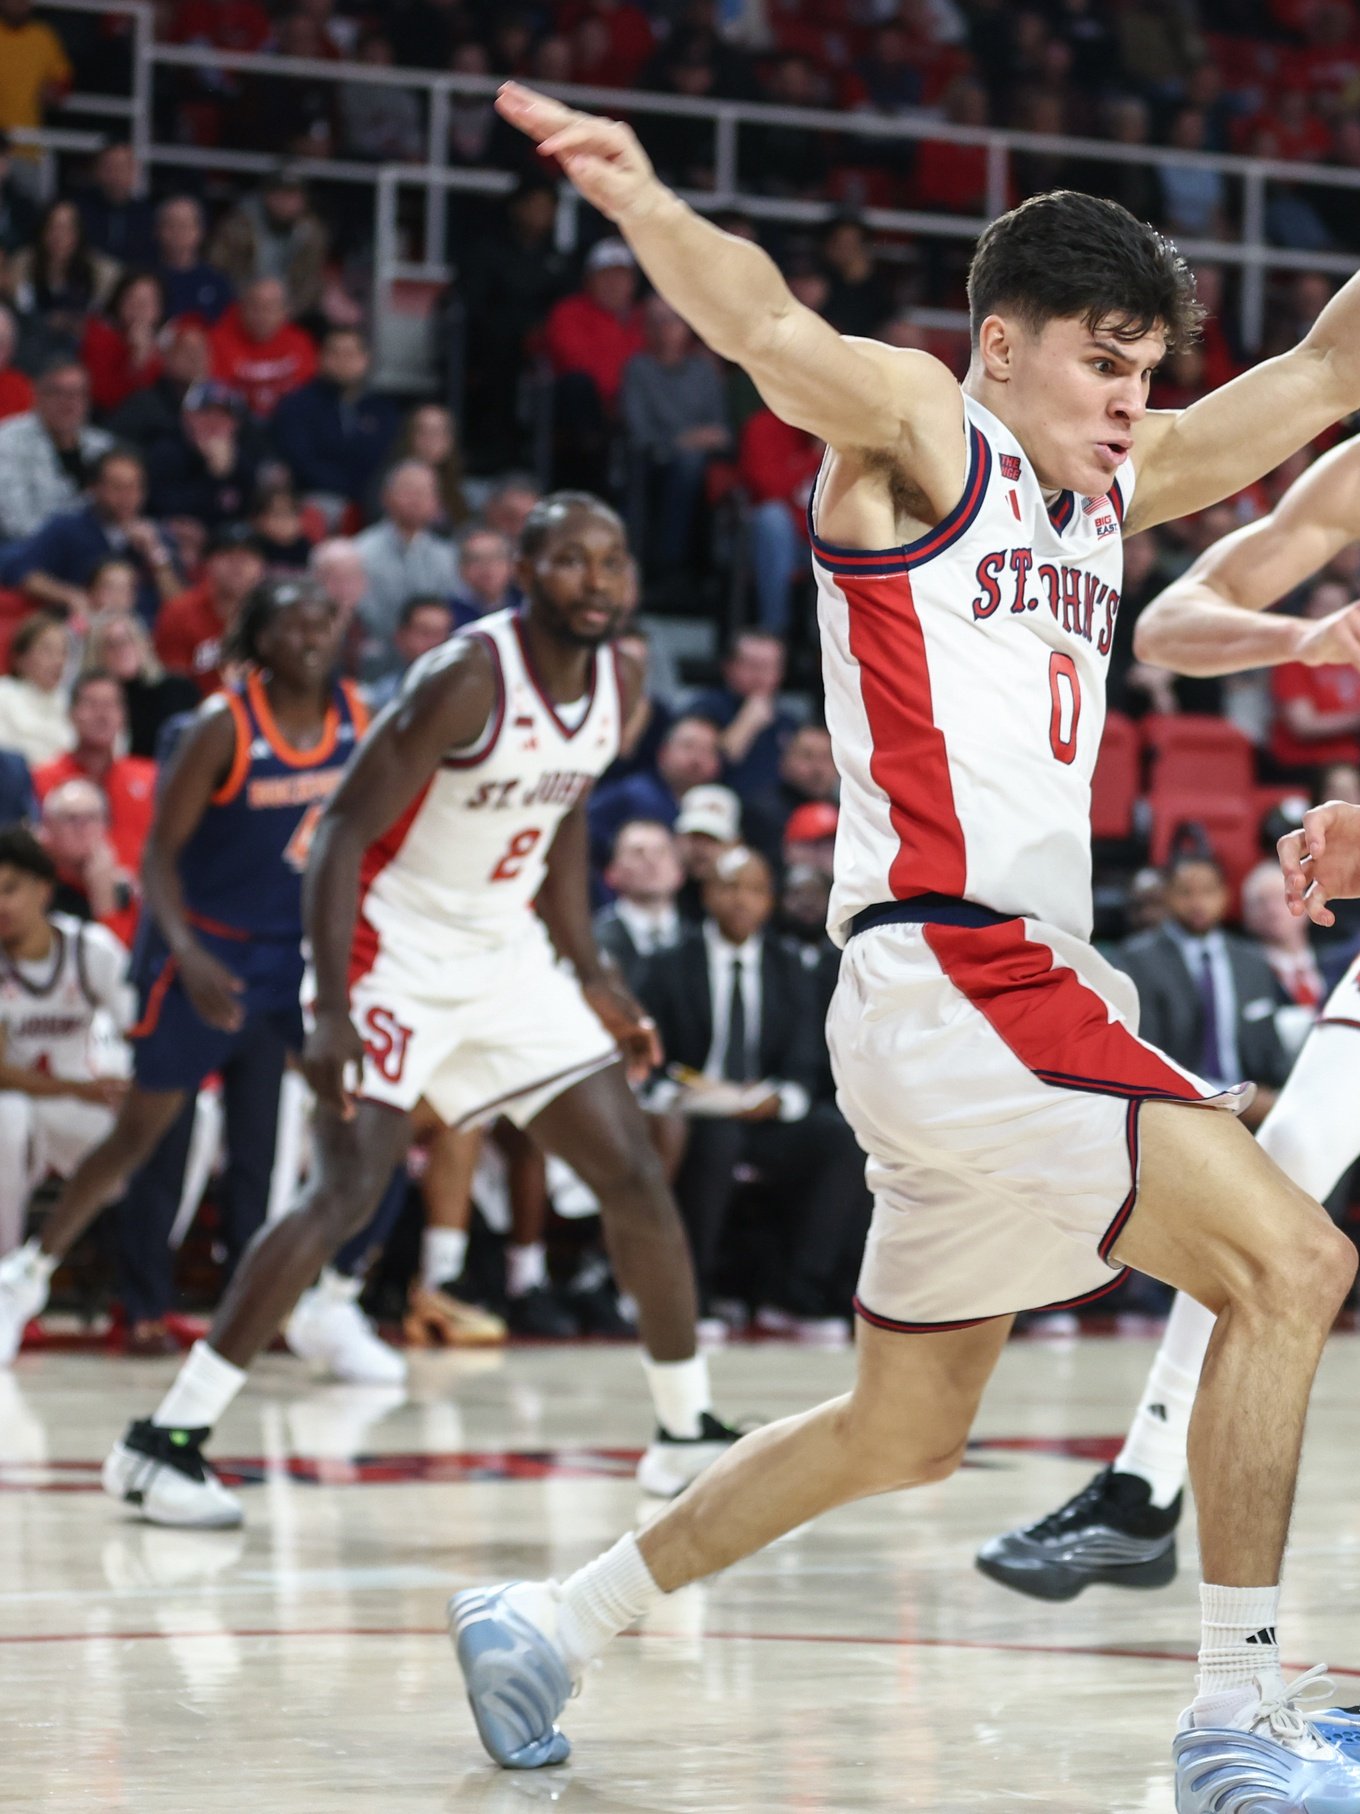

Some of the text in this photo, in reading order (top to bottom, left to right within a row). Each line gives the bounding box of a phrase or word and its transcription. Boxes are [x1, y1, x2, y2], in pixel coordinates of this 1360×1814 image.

[1094, 514, 1111, 528] BIG
[1096, 523, 1117, 536] EAST
[972, 547, 1120, 656] ST. OHN'S
[1048, 651, 1081, 766] 0
[489, 826, 542, 882] 2
